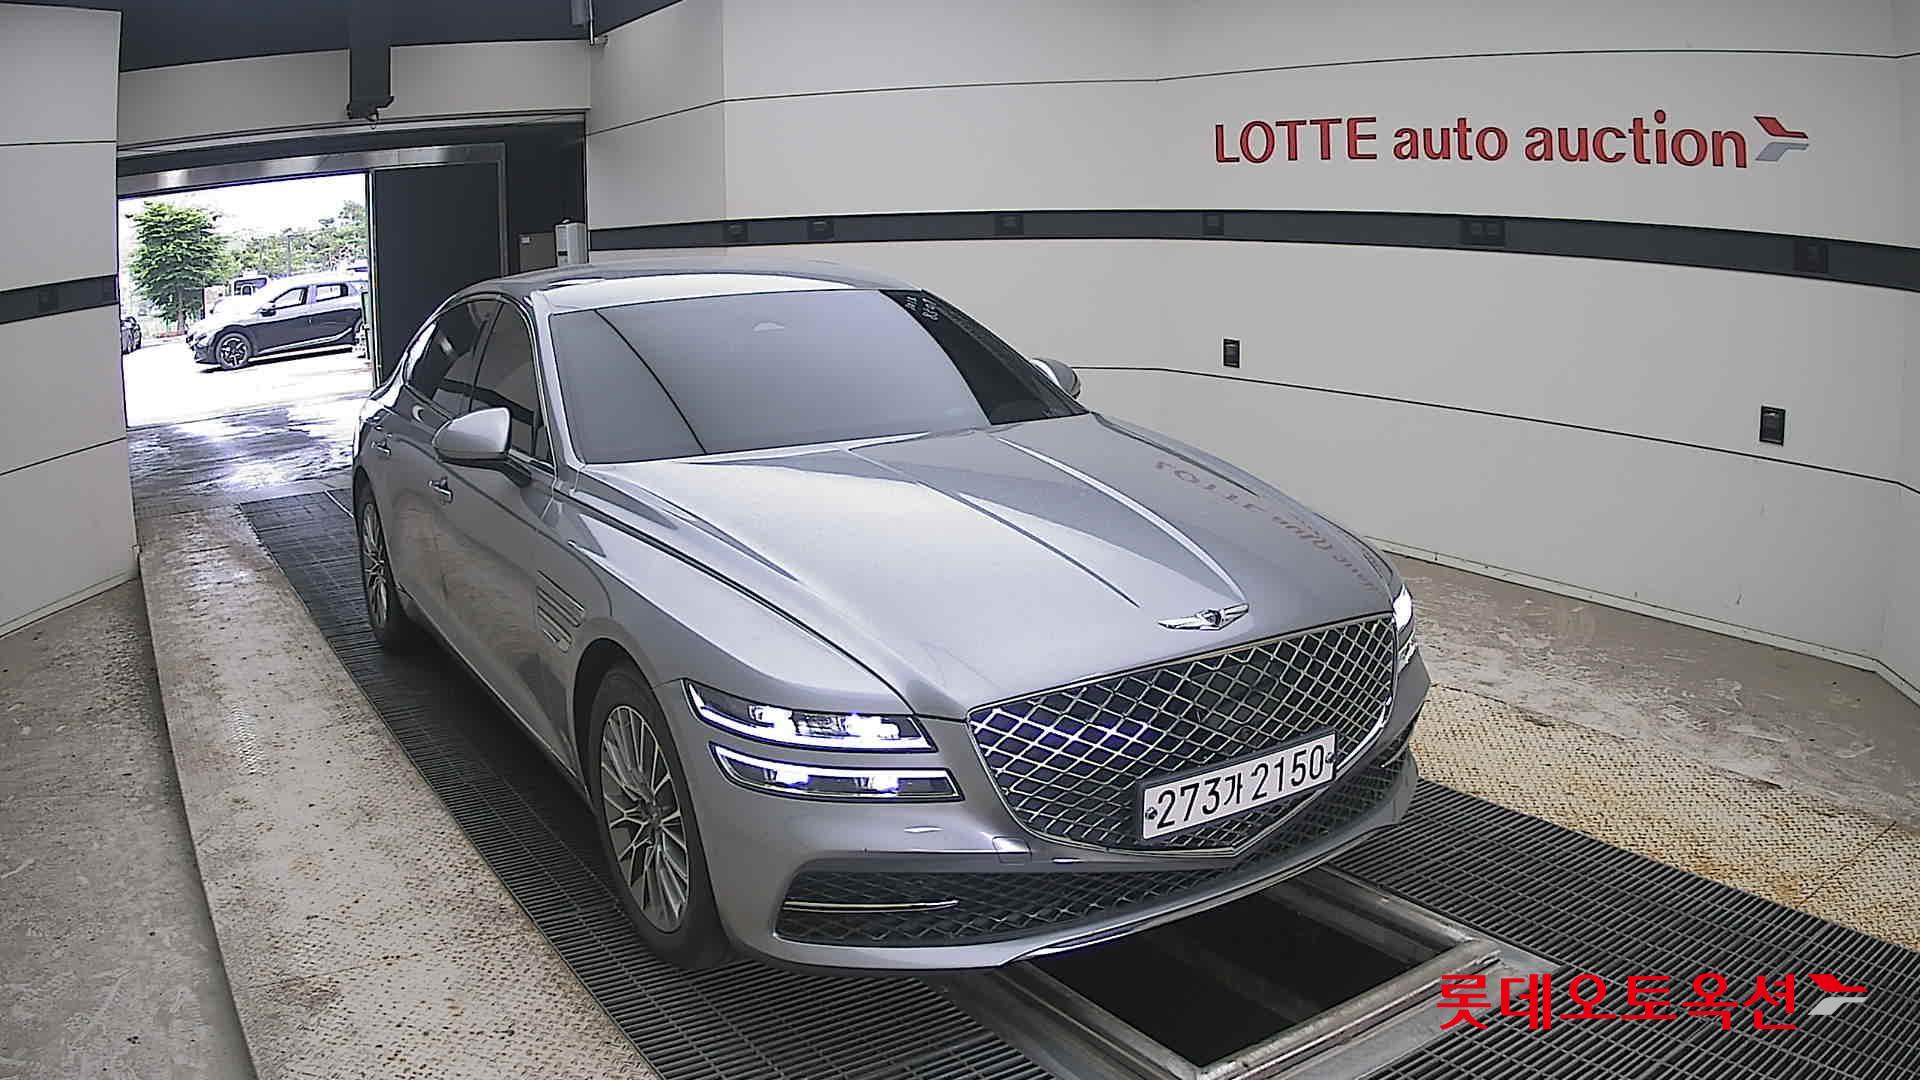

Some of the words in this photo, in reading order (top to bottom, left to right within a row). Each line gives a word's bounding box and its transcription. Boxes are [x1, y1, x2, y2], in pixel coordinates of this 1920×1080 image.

[1215, 116, 1378, 164] LOTTE
[1393, 117, 1509, 162] auto
[1524, 109, 1748, 169] auction
[1156, 772, 1243, 830] 273가
[1251, 744, 1325, 801] 2150
